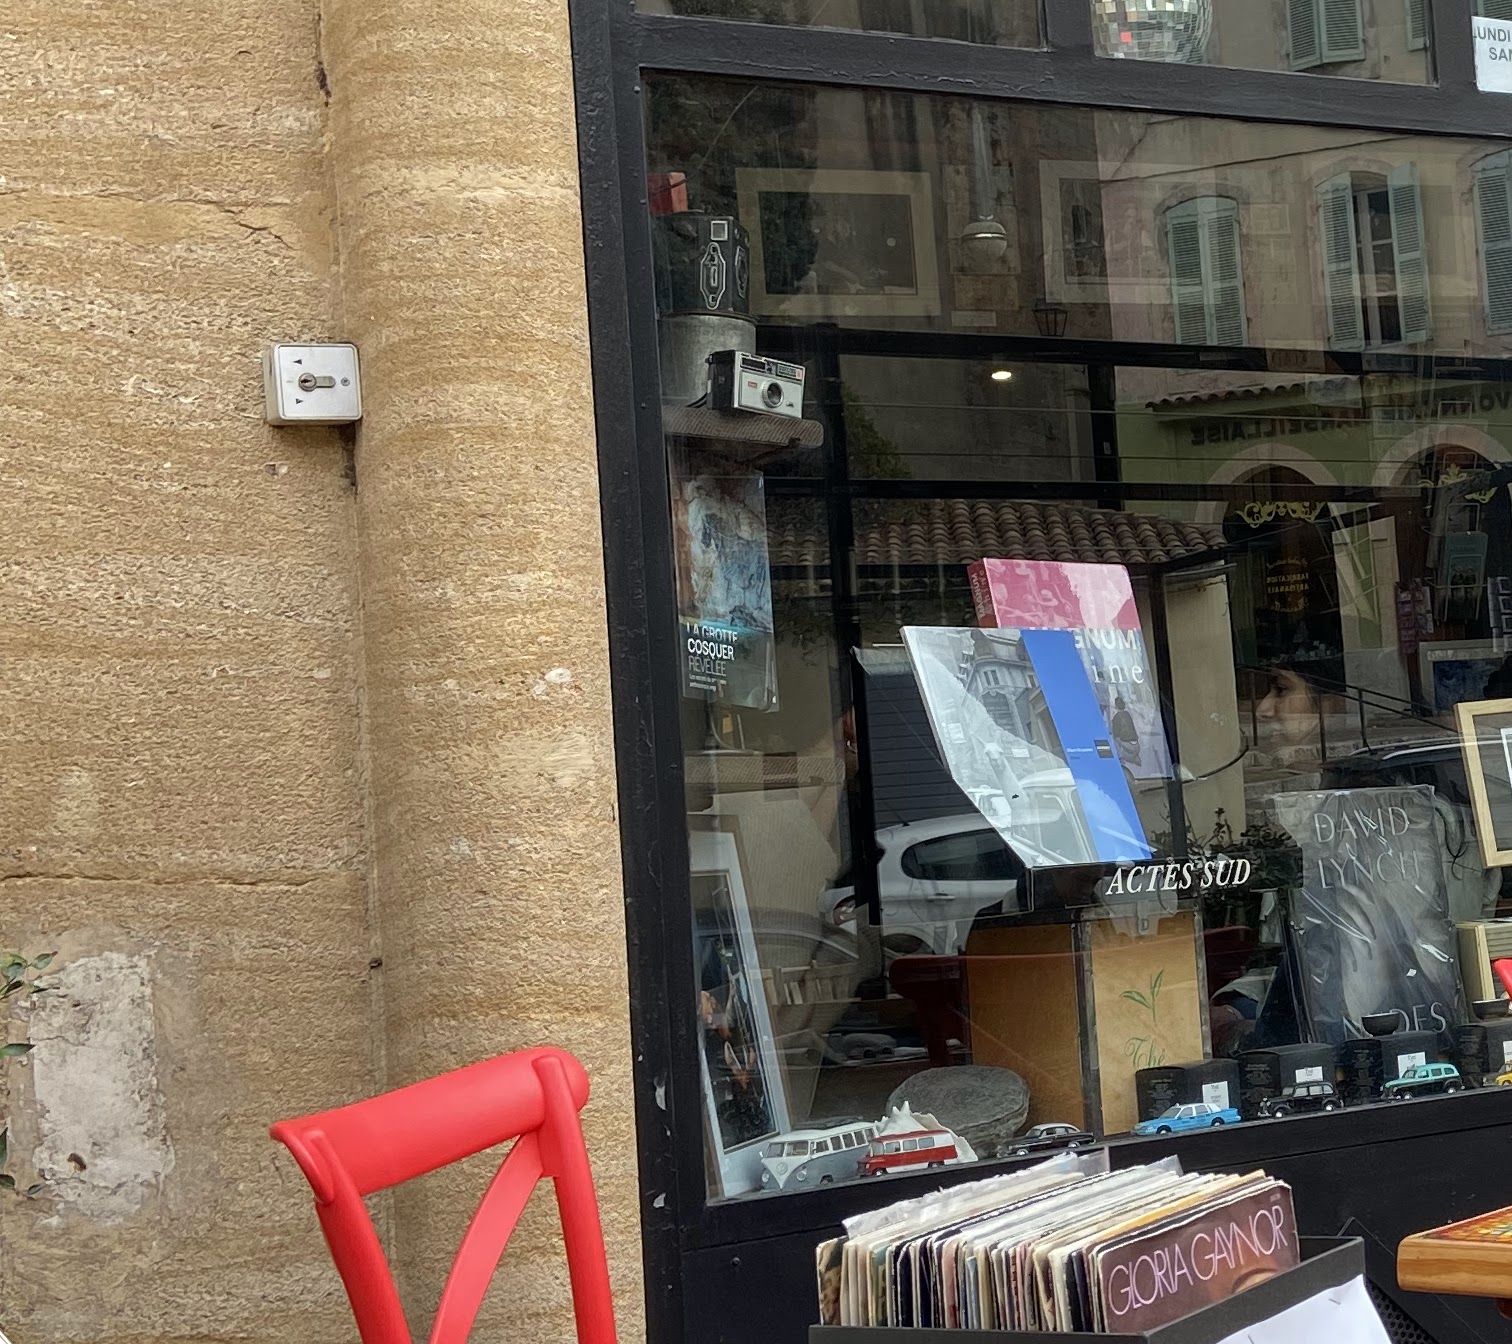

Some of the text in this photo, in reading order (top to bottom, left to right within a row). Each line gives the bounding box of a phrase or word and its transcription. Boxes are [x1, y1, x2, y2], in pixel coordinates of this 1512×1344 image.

[687, 638, 734, 660] COSQUER
[1105, 858, 1251, 895] ACTES SUD
[1343, 1001, 1446, 1039] NDES
[1107, 1204, 1289, 1317] GLORIA GAYNOR
